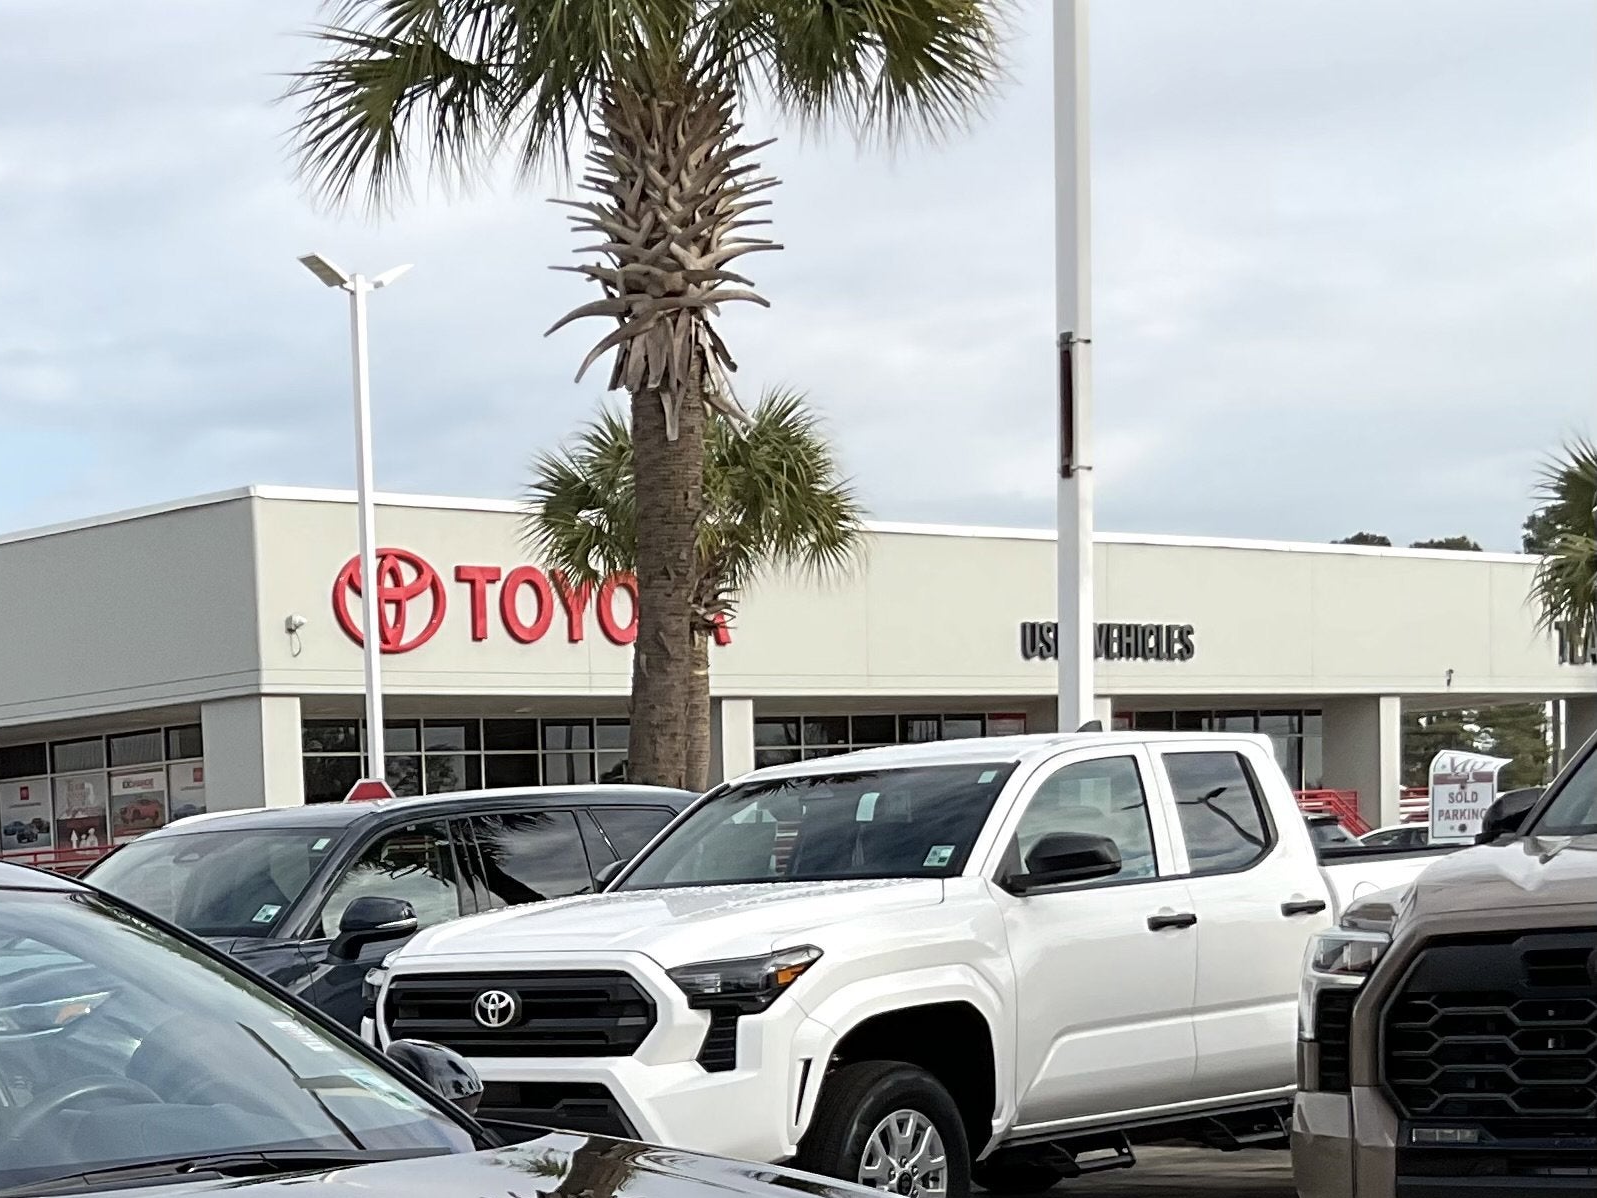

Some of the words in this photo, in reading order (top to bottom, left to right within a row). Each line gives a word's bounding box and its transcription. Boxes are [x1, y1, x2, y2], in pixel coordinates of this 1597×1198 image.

[454, 565, 731, 646] TOYO
[1093, 622, 1195, 661] VEHICLES
[1448, 791, 1478, 803] SOLD
